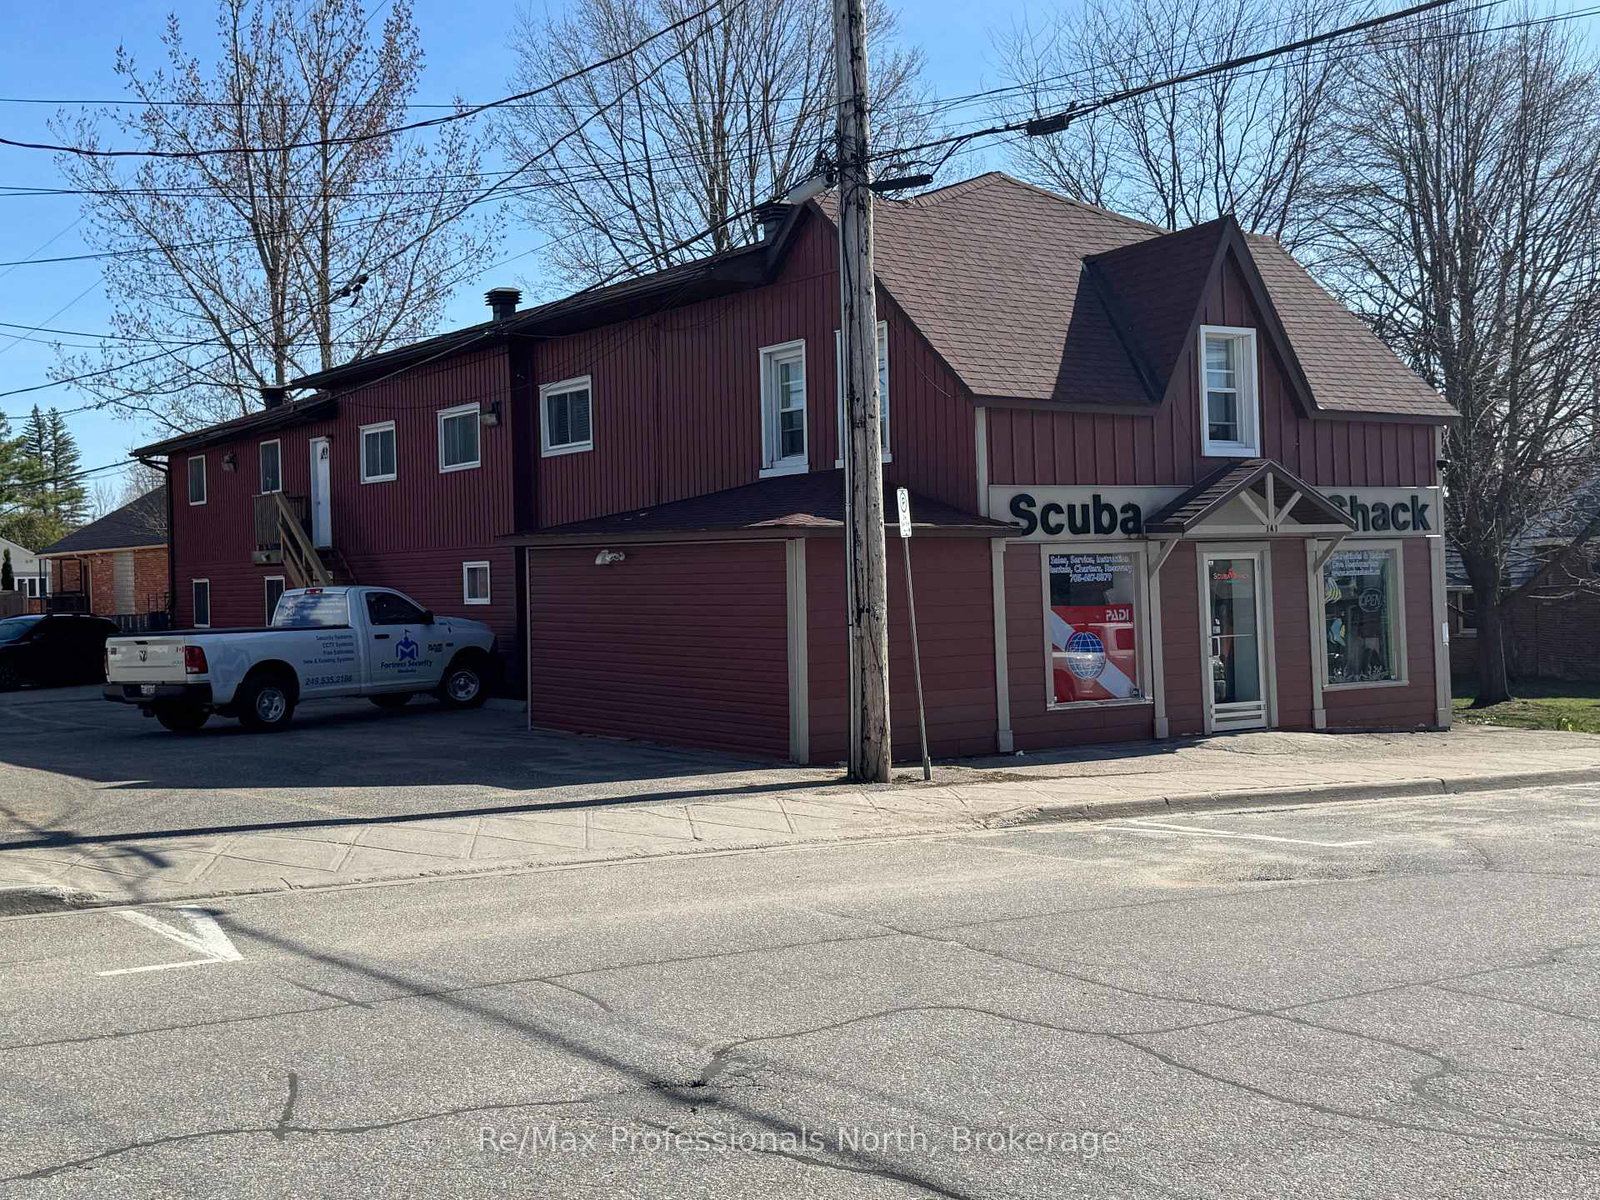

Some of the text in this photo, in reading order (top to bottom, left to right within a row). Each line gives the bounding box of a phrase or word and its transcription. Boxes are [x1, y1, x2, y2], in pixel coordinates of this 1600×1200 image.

[1009, 493, 1142, 536] Scuba
[1106, 609, 1129, 621] PADI
[380, 659, 433, 669] Fortress Security
